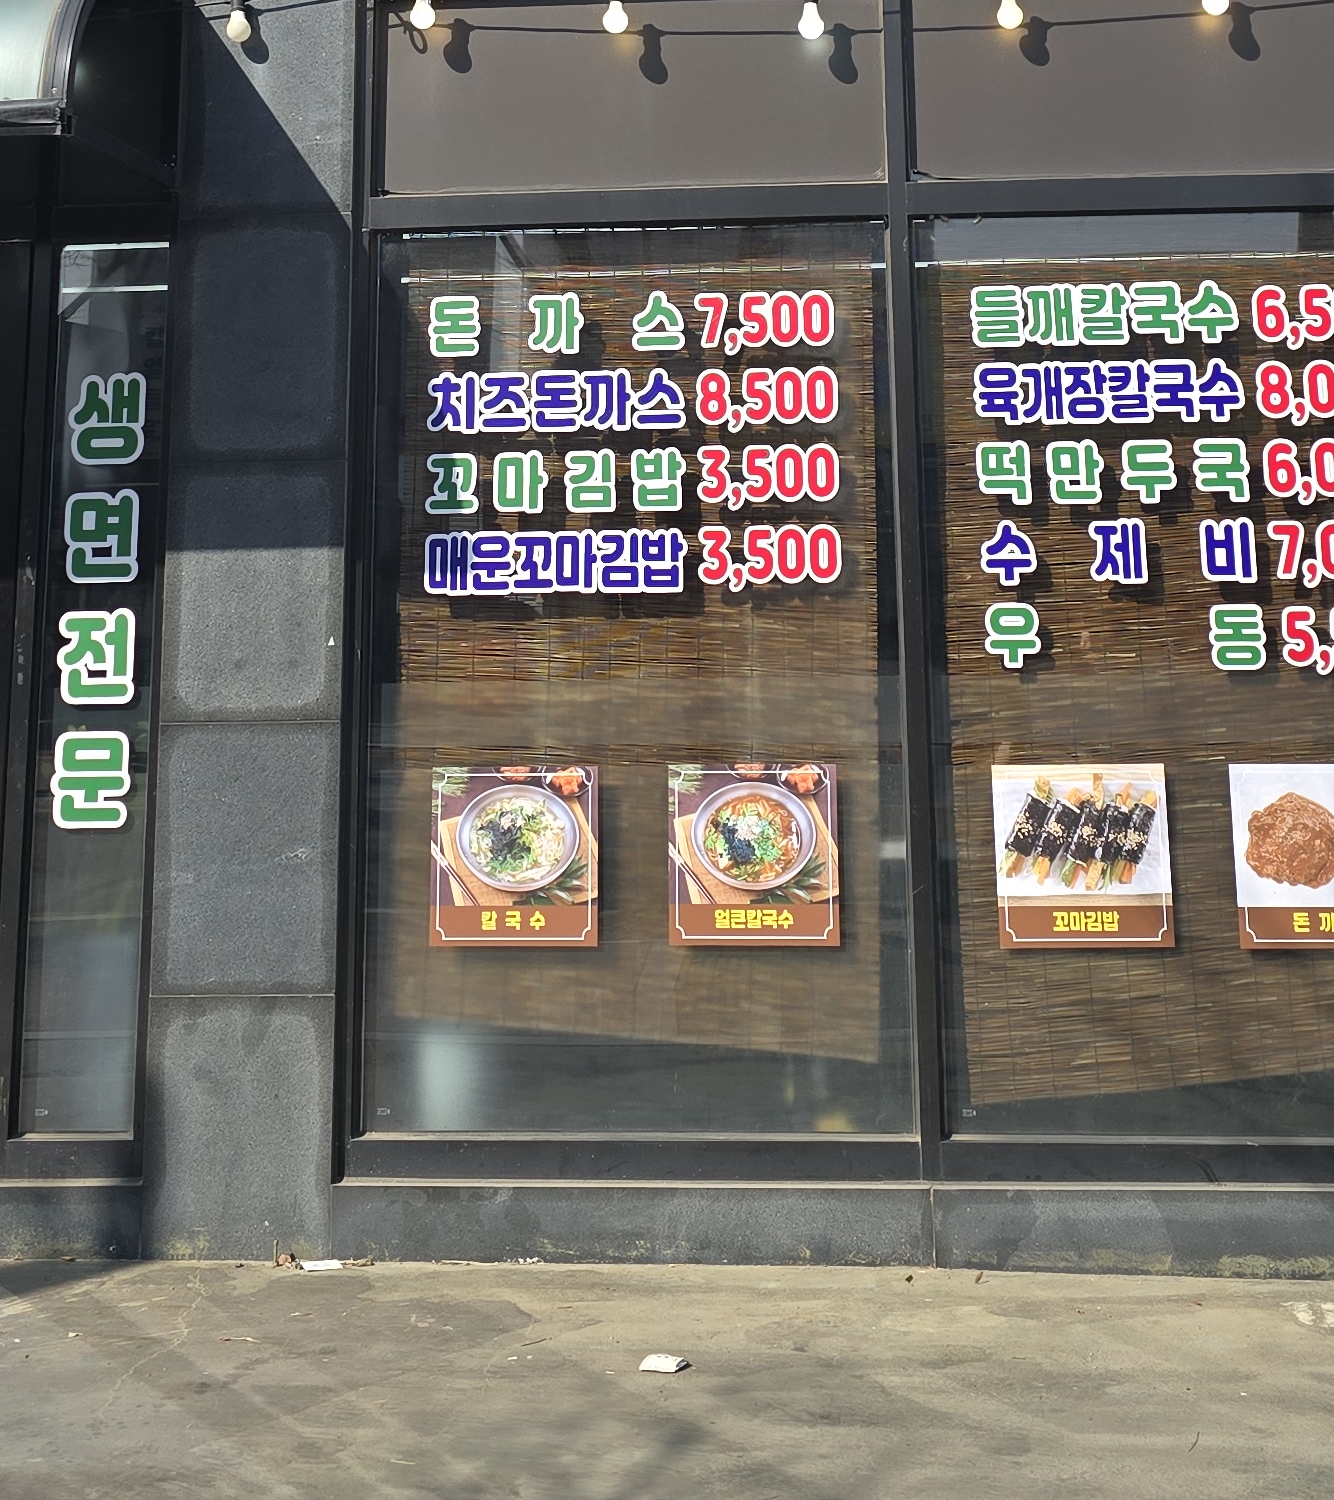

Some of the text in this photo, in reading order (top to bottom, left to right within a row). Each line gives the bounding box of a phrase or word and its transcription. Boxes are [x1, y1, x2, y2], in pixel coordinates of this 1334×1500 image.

[694, 290, 835, 355] 7,500
[970, 280, 1239, 348] 들깨칼국수
[426, 366, 839, 435] 치즈돈까스 8,500
[973, 357, 1245, 426] 육개장칼국수
[425, 442, 840, 514] 꼬마김밥 3,500
[975, 436, 1251, 506] 떡만두국
[424, 523, 842, 596] 매운꼬마김밥 3,500
[50, 372, 147, 829] 생면전문
[480, 909, 546, 931] 칼국수
[714, 909, 794, 931] 얼큰칼국수
[1052, 910, 1120, 933] 꼬마김밥
